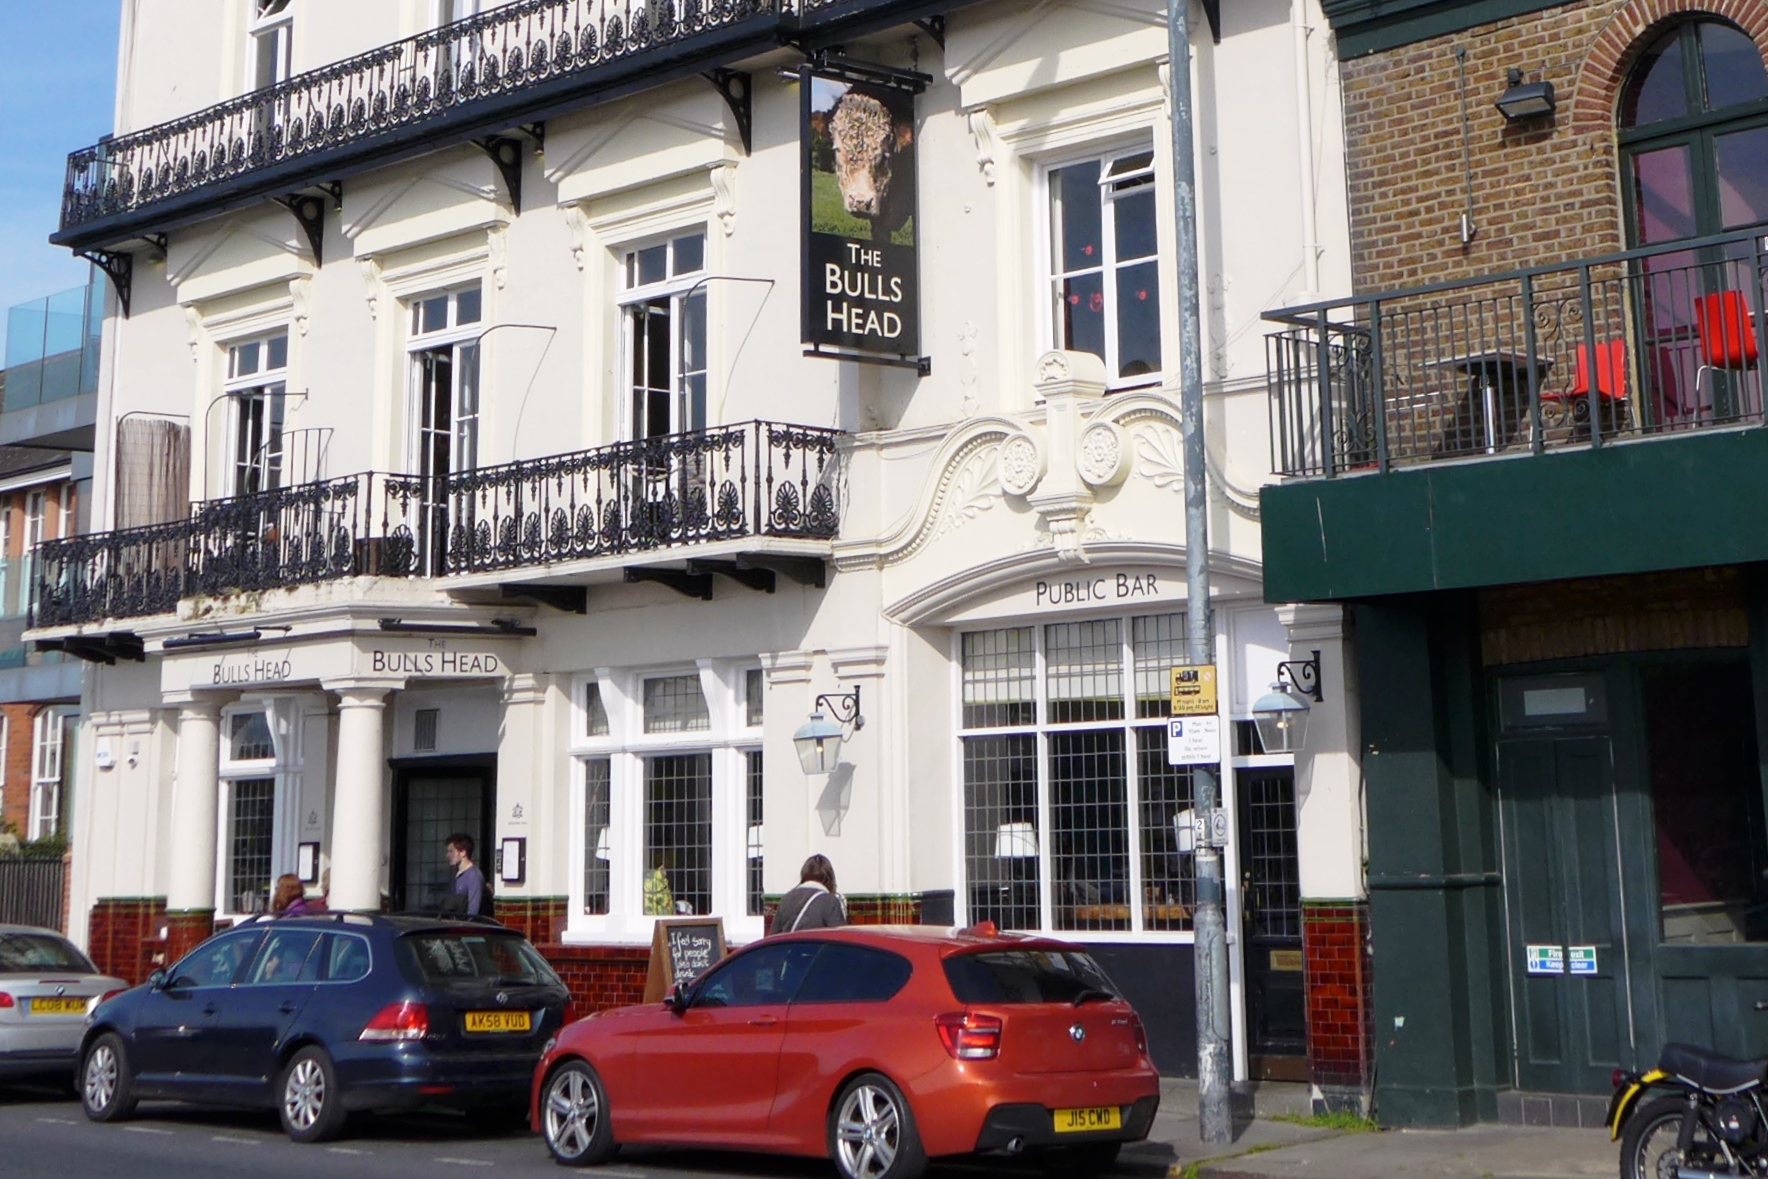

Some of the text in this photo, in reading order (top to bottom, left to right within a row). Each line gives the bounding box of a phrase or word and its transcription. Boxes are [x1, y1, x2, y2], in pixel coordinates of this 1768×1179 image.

[847, 242, 882, 267] THE
[825, 262, 902, 303] BULLS
[827, 299, 902, 338] HEAD
[1036, 573, 1159, 606] PUBLIC BAR
[428, 638, 446, 649] THE
[213, 659, 291, 685] BULLS HEAD
[373, 650, 498, 673] BULLS HEAD
[670, 932, 676, 945] I
[692, 936, 711, 951] sorry
[684, 948, 709, 961] people
[471, 1012, 525, 1028] AK58 VUD
[1067, 1108, 1111, 1127] J15 CWD
